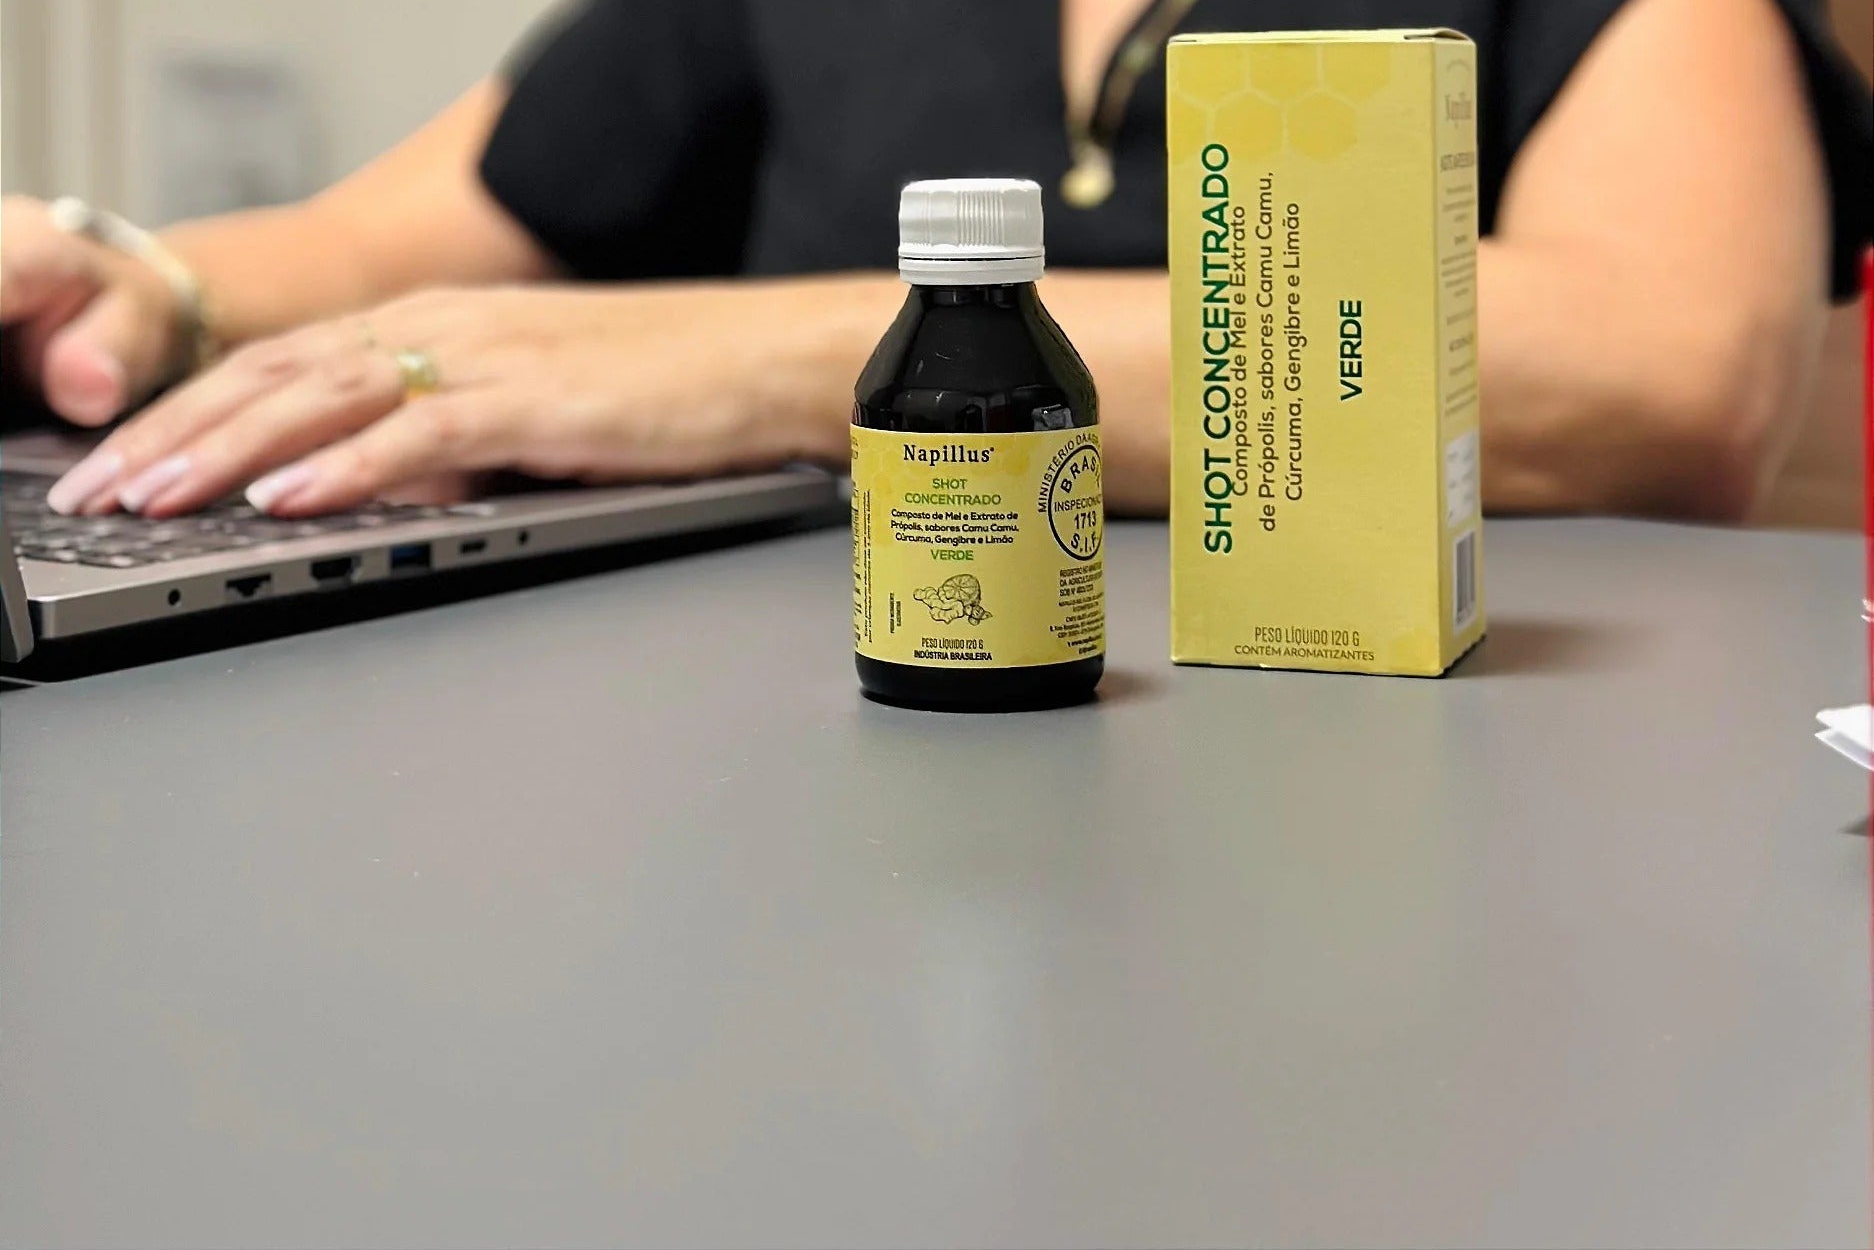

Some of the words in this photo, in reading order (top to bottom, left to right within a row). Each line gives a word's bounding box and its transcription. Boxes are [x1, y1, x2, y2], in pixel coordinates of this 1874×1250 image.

[1255, 172, 1274, 240] Camu,
[1229, 206, 1246, 287] Extrato
[1282, 203, 1301, 269] Limão
[1256, 246, 1274, 308] Camu
[1286, 274, 1301, 287] e
[1201, 143, 1232, 440] CONCENTRADO
[1233, 292, 1247, 306] e
[1229, 311, 1247, 349] Mel
[1283, 293, 1308, 392] Gengibre
[1256, 313, 1275, 400] sabores
[1339, 300, 1363, 402] VERDE
[1230, 354, 1247, 382] de
[1232, 386, 1252, 496] Composto
[1257, 405, 1280, 499] Própolis,
[1284, 397, 1304, 501] Cúrcuma,
[932, 478, 968, 490] SHOT
[1038, 440, 1075, 513] MINISTÉRIO
[904, 492, 1002, 506] CONCENTRADO
[1203, 448, 1233, 554] SHOT
[890, 520, 924, 533] Própolis,
[925, 523, 961, 532] sabores
[961, 523, 989, 532] Camu
[891, 508, 931, 521] Composto
[932, 511, 944, 521] de
[945, 512, 962, 521] Mel
[963, 513, 969, 521] e
[970, 512, 1006, 521] Extrato
[1006, 511, 1019, 520] de
[1074, 510, 1097, 530] 1713
[1259, 504, 1276, 532] de
[930, 549, 974, 561] VERDE
[934, 535, 977, 547] Gengibre
[922, 637, 938, 649] PESO
[1254, 626, 1283, 644] PESO
[1285, 625, 1328, 646] LÍQUIDO
[1352, 630, 1360, 647] G
[913, 649, 949, 660] INDÚSTRIA
[950, 652, 993, 661] BRASILEIRA
[1234, 644, 1282, 657] CONTÉM
[1283, 647, 1375, 661] AROMATIZANTES
